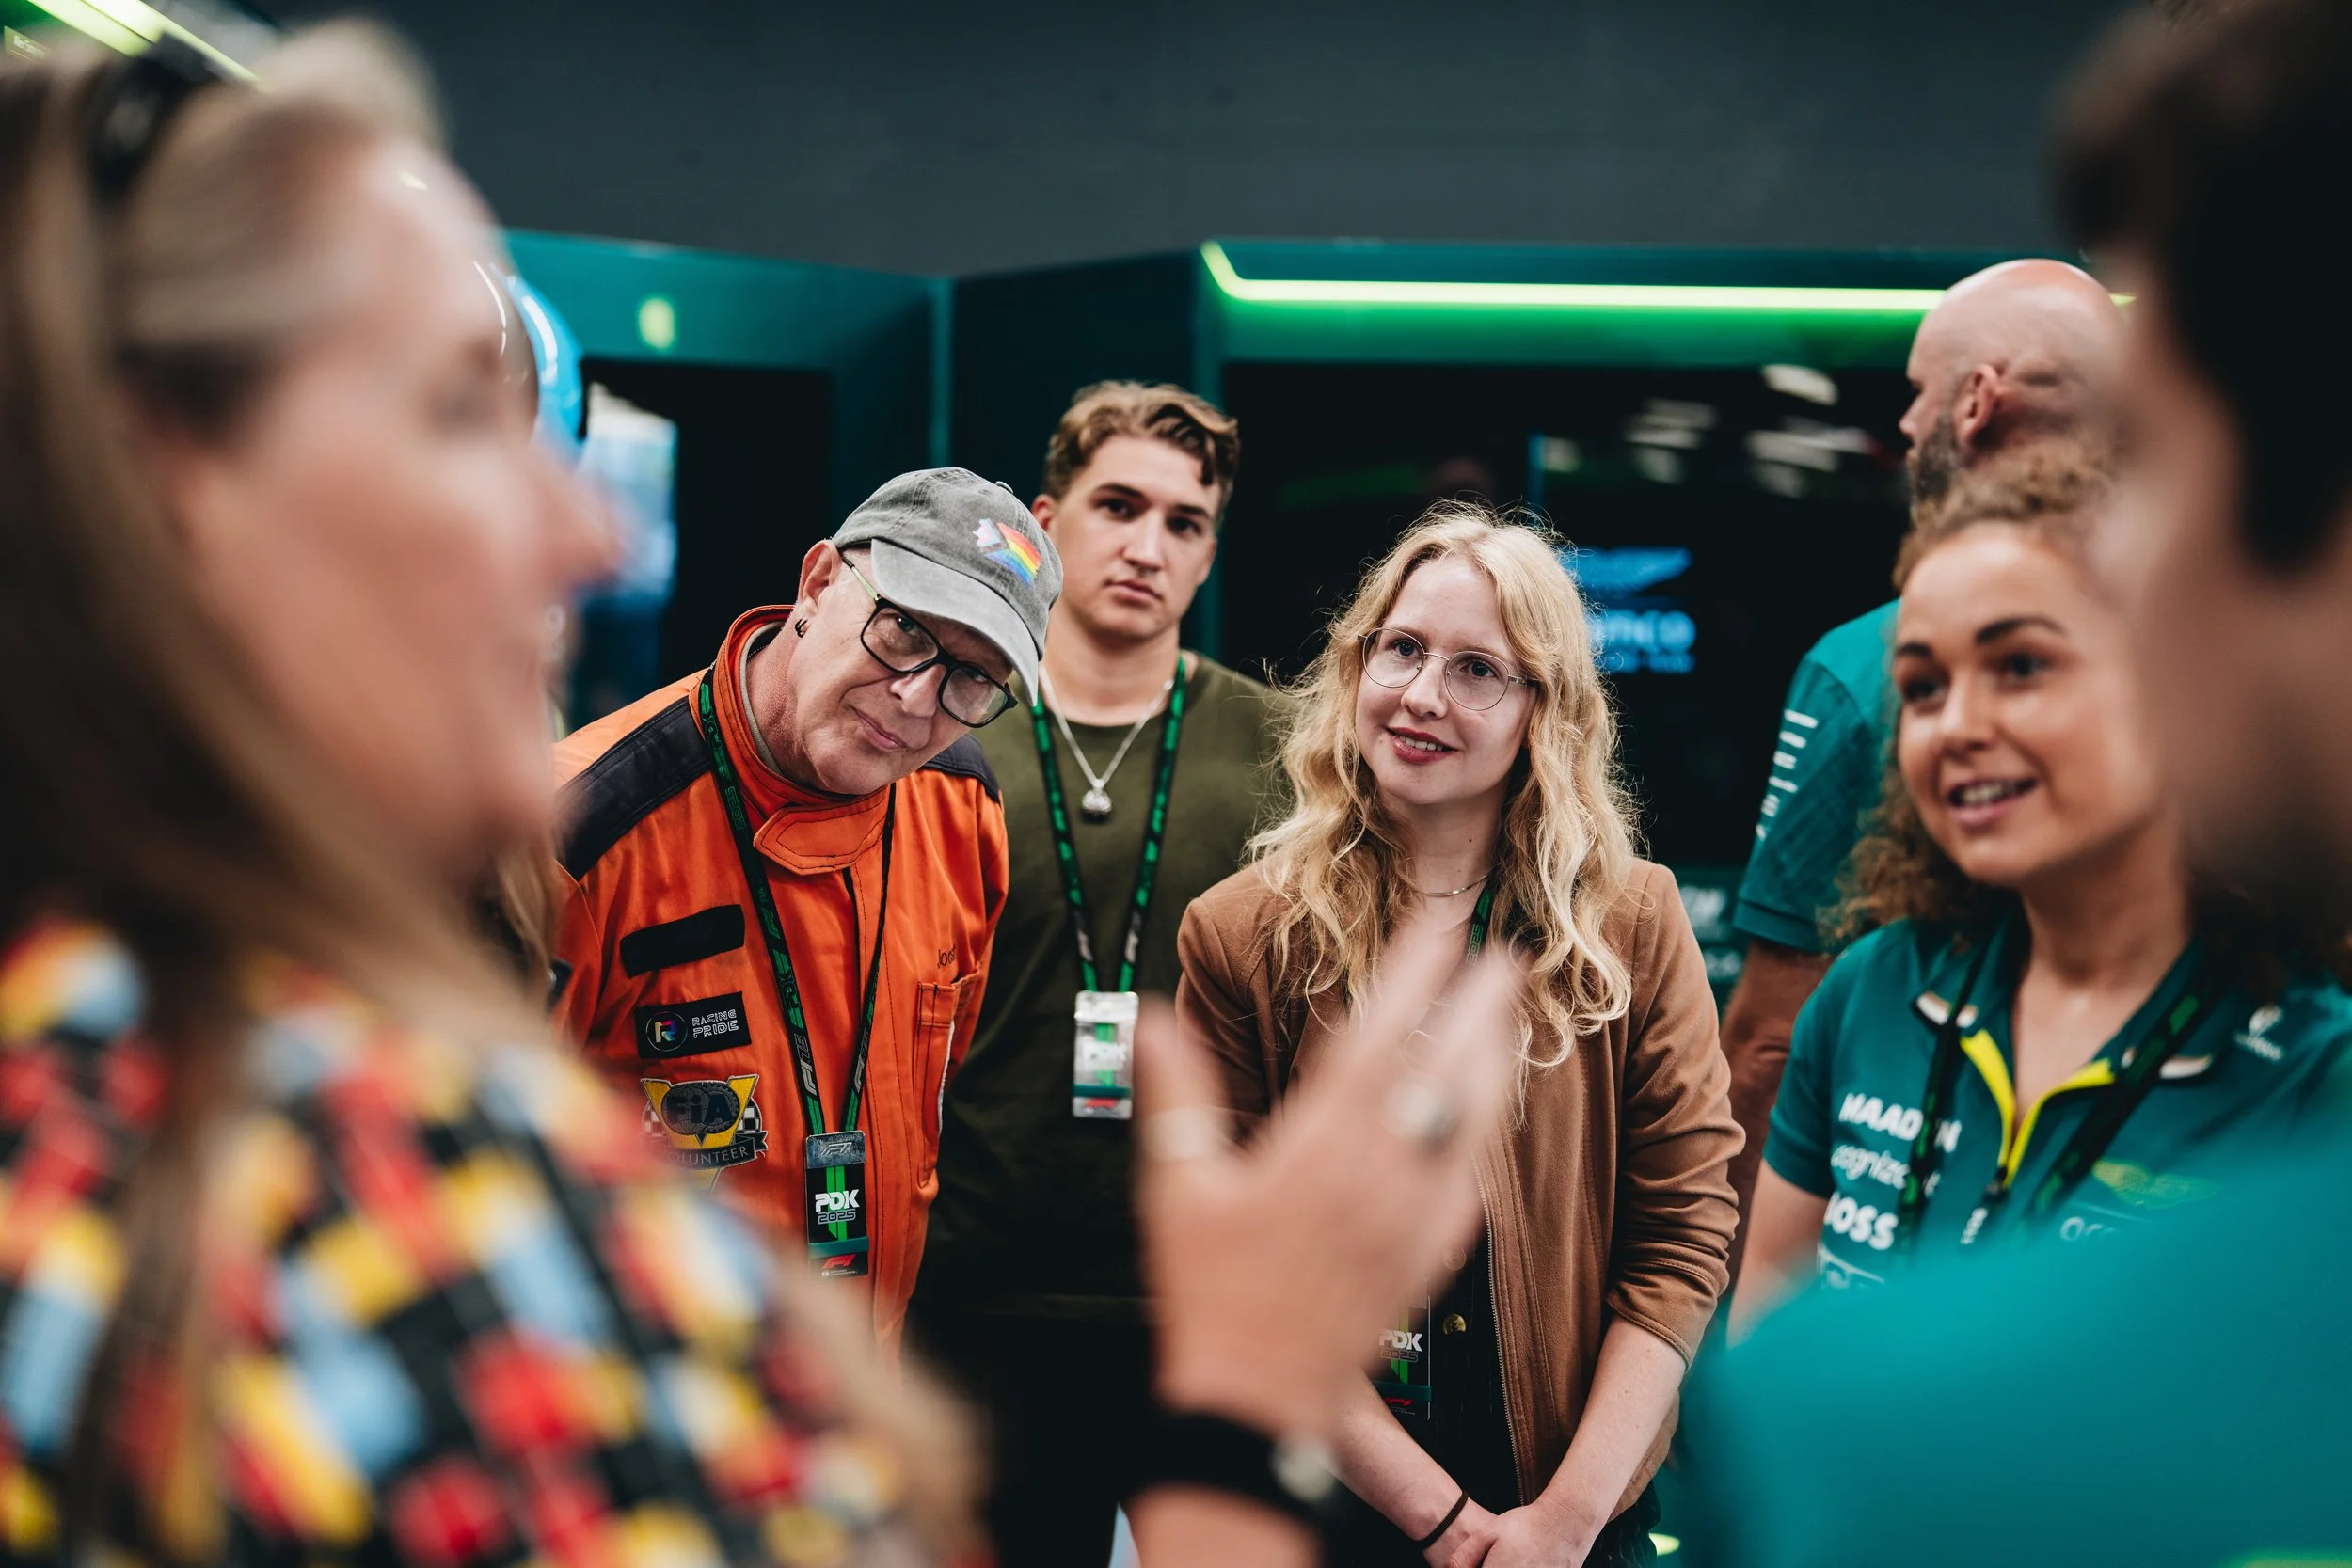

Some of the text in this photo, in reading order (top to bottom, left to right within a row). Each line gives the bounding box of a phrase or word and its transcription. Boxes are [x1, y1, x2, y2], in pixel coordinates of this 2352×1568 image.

[691, 1008, 737, 1027] RACING
[692, 1019, 739, 1039] PRIDE
[1838, 1092, 1963, 1153] MAADN
[662, 1146, 750, 1165] OLUNTEER
[815, 1189, 861, 1213] PDK
[817, 1208, 857, 1226] 2025
[1378, 1328, 1423, 1352] PDK
